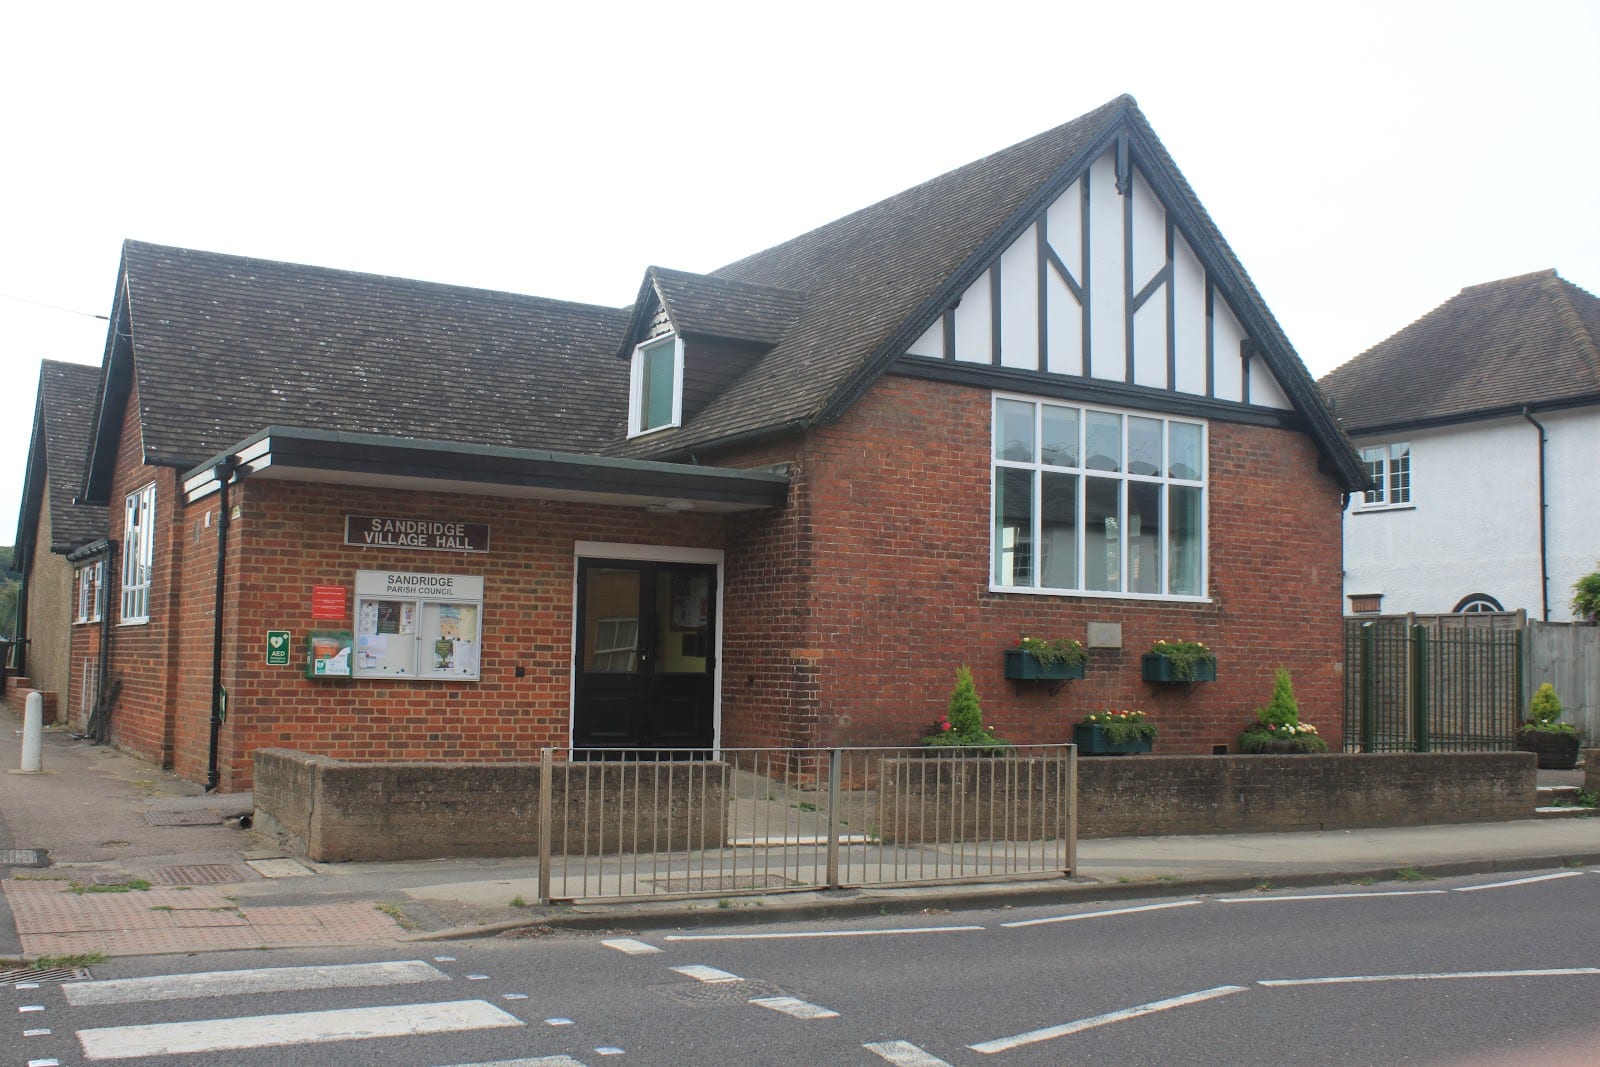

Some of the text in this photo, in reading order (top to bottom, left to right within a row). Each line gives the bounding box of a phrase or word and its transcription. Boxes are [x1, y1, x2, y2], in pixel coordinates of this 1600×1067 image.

[371, 518, 465, 536] SANDRIDGE
[364, 531, 473, 549] VILLAGE HALL
[387, 574, 454, 587] SANDRIDGE
[387, 586, 454, 595] PARISH COUNCIL
